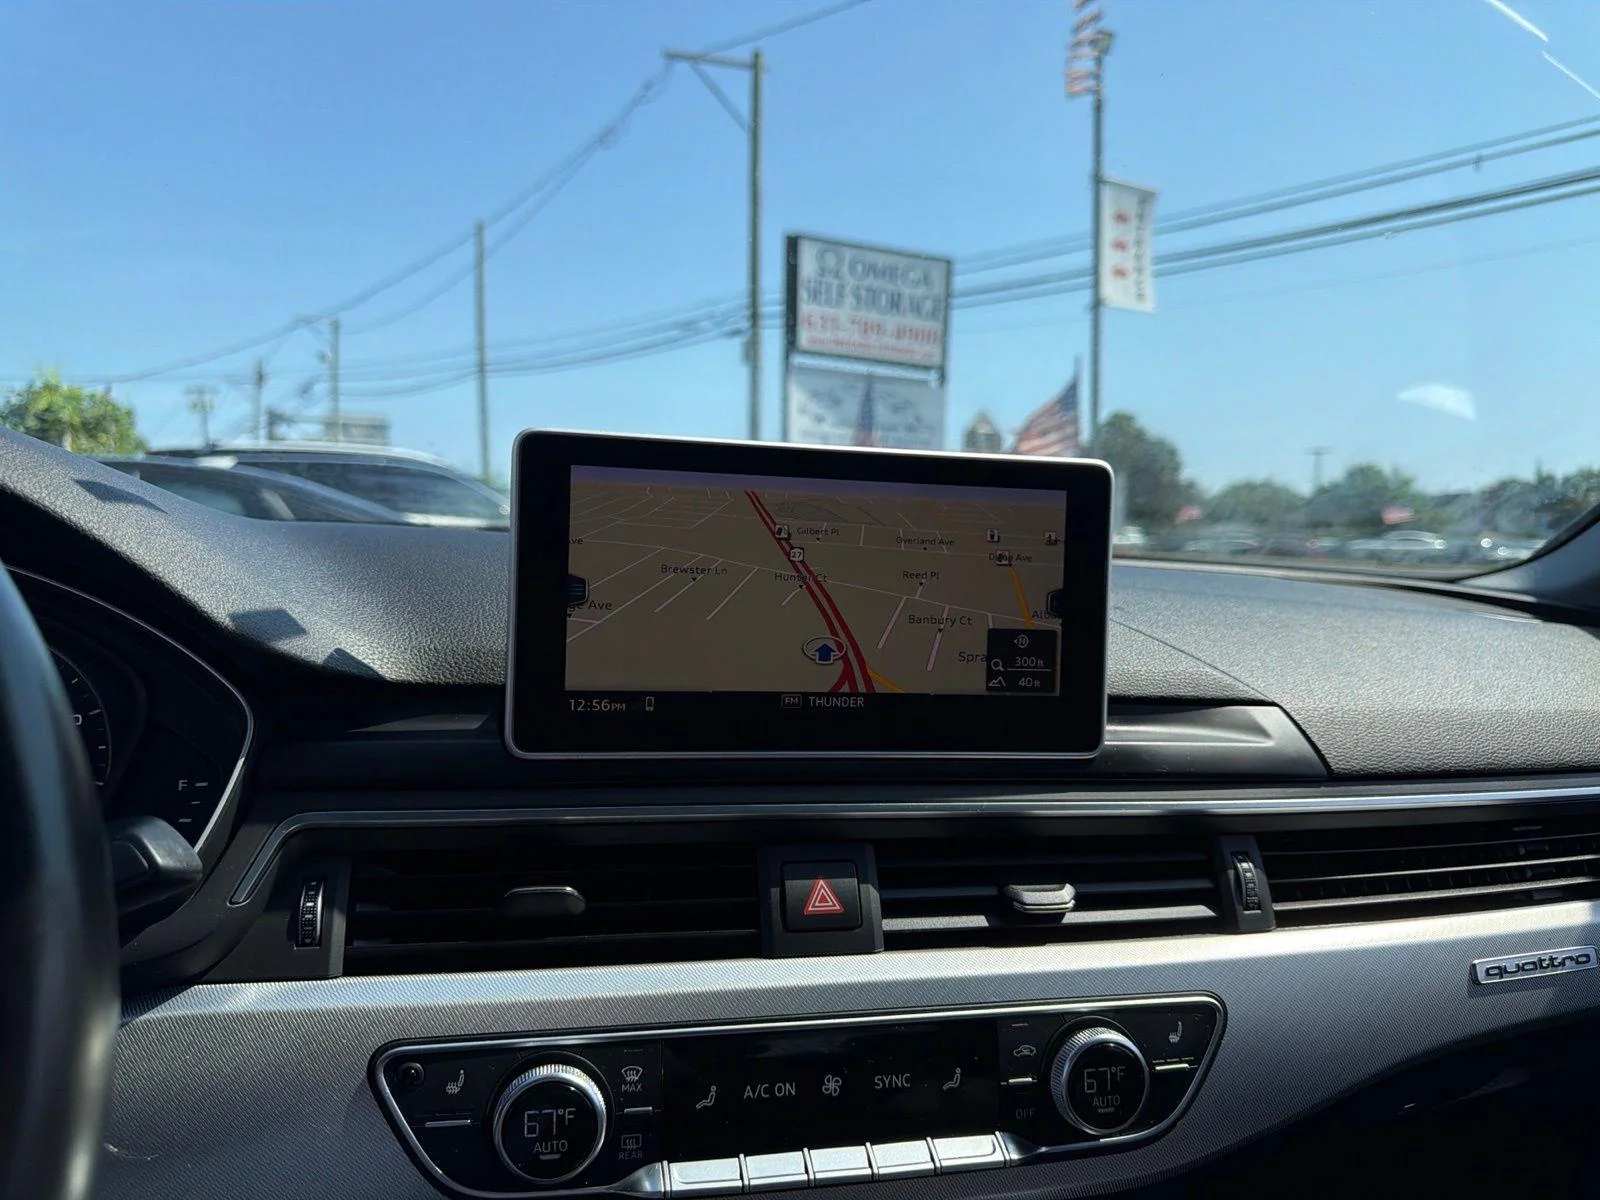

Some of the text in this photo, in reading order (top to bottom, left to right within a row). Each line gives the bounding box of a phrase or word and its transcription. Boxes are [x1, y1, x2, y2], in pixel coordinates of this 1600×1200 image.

[848, 255, 938, 288] OMEGA
[797, 527, 829, 536] Gilbert
[897, 536, 955, 546] Overland Ave
[1015, 553, 1032, 562] Ave
[660, 564, 728, 576] Brewster Ln
[902, 570, 940, 580] Reed Pl
[774, 573, 827, 582] Hunter Ct
[588, 600, 613, 610] Ave
[908, 614, 973, 627] Banbury Ct
[784, 696, 865, 708] FM THUNDER
[178, 779, 188, 791] F
[1484, 952, 1592, 979] quattro
[874, 1073, 912, 1090] SYNC
[621, 1082, 642, 1094] MAX
[743, 1082, 796, 1100] A/C ON
[1092, 1095, 1121, 1107] AUTO
[1015, 1107, 1036, 1121] OFF
[533, 1139, 569, 1154] AUTO
[618, 1148, 644, 1161] REAR
